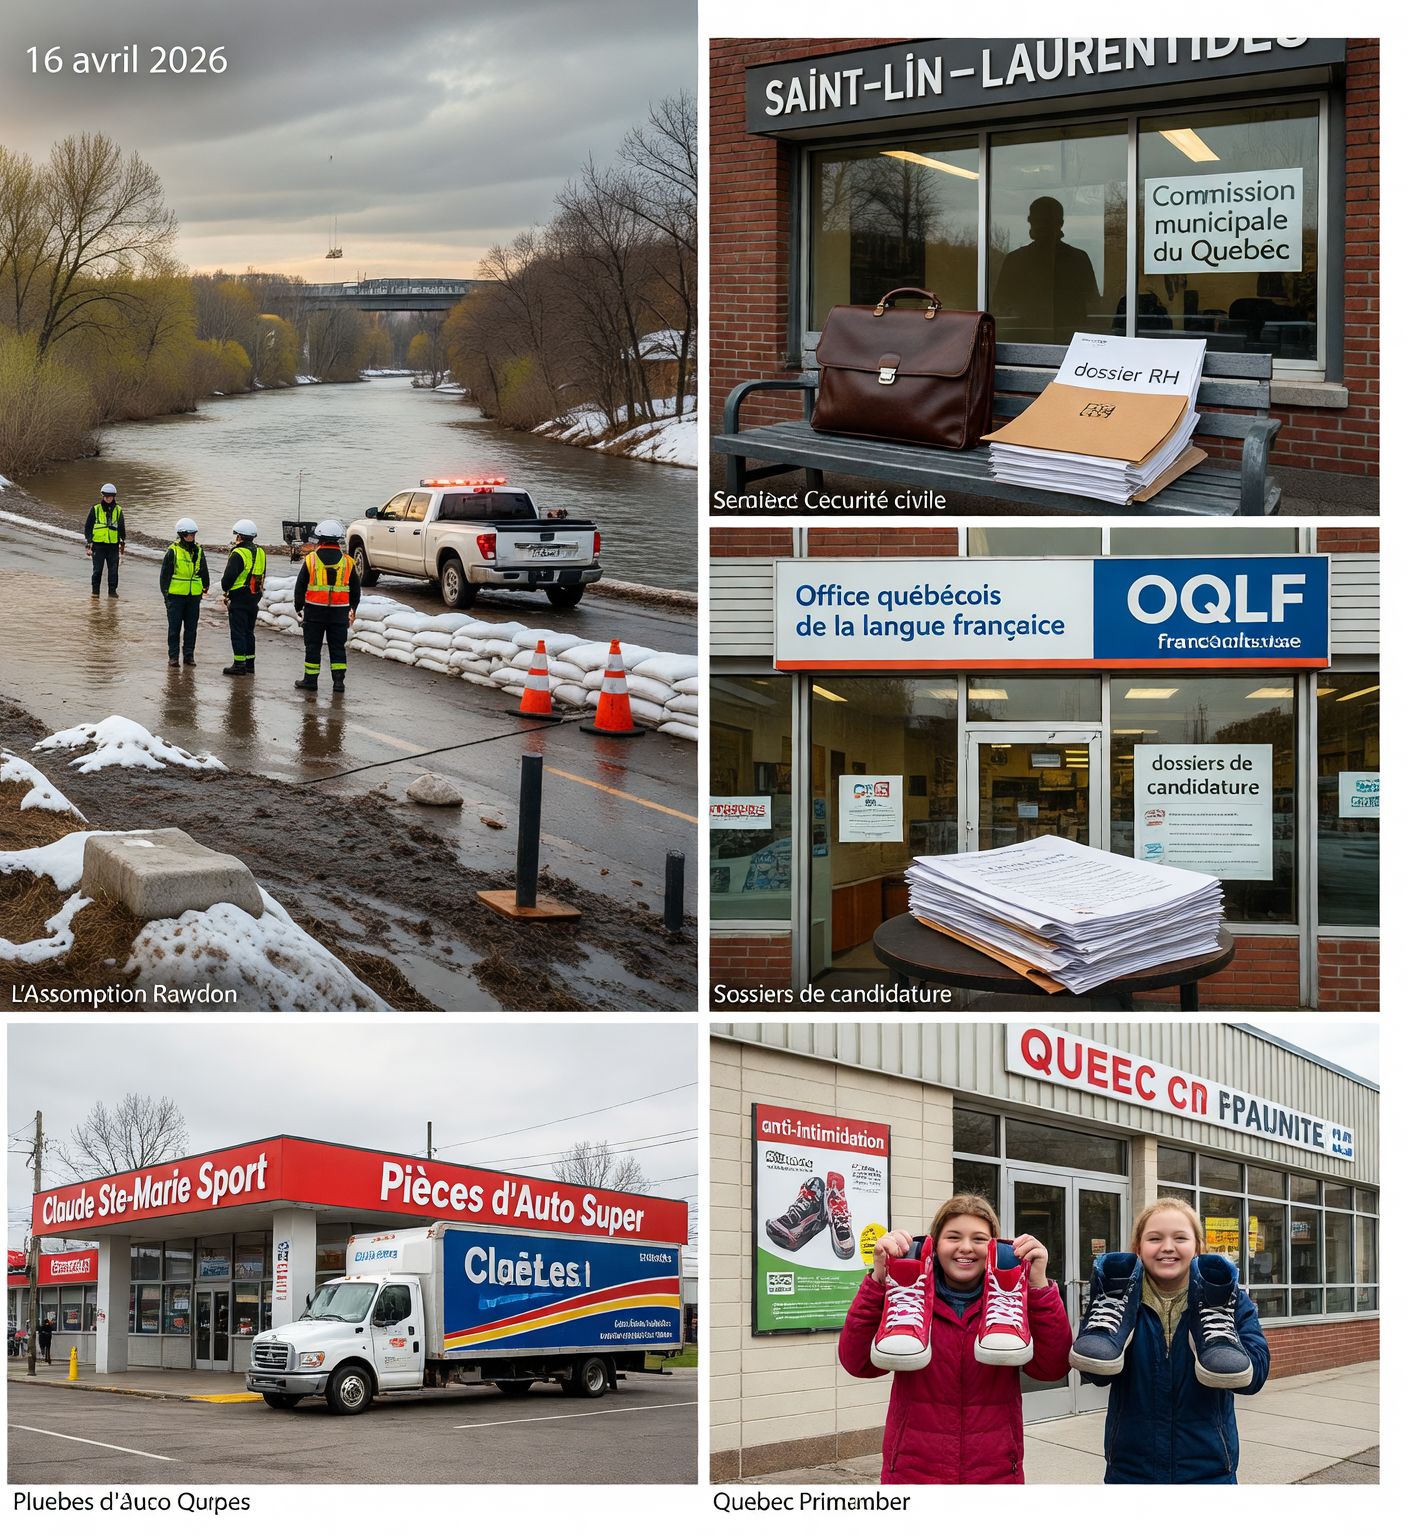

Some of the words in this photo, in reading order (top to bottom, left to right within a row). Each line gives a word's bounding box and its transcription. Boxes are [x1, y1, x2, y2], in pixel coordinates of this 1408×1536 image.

[1153, 180, 1295, 206] Commission
[1155, 207, 1288, 238] municipale
[1153, 241, 1182, 261] du
[1074, 362, 1142, 382] dossier
[1148, 368, 1180, 385] RH
[796, 584, 870, 606] Office
[877, 584, 1002, 612] québécois
[1127, 574, 1307, 624] OQLF
[796, 614, 826, 636] de
[835, 614, 854, 636] la
[863, 614, 945, 641] langue
[1152, 754, 1225, 771] dossiers
[1230, 754, 1253, 771] de
[1147, 778, 1260, 795] candidature
[1021, 1028, 1157, 1101] QUEEC
[761, 1119, 885, 1150] anti-intimidation
[43, 1188, 95, 1225] Claude
[98, 1168, 192, 1217] Ste-Marie
[197, 1152, 268, 1205] Sport
[380, 1161, 484, 1213] Pièces
[491, 1180, 575, 1224] d'Auto
[580, 1193, 645, 1237] Super
